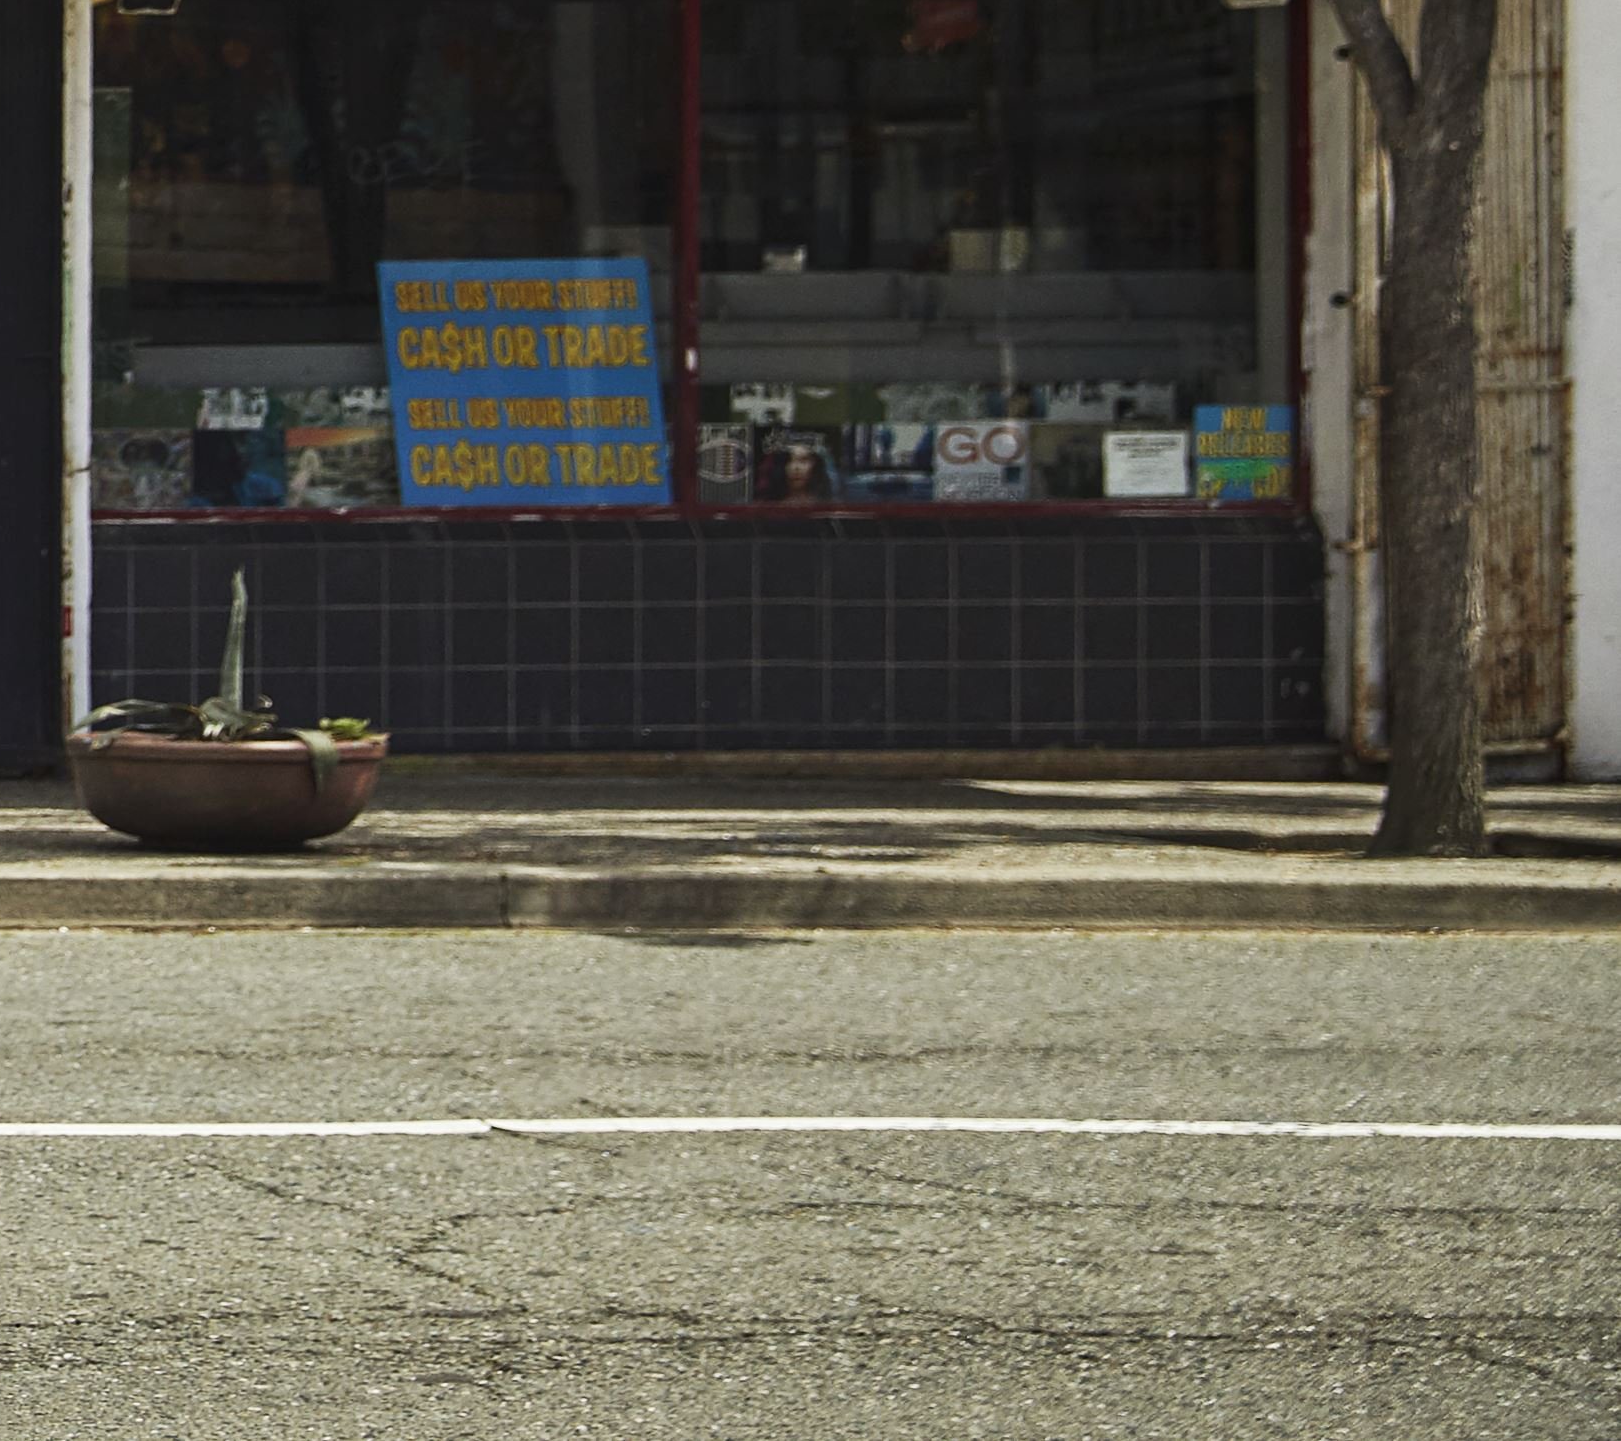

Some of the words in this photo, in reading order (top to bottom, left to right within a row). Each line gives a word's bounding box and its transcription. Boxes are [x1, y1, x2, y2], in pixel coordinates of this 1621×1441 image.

[394, 278, 450, 312] SELL
[454, 278, 487, 311] US
[490, 278, 554, 311] YOUR
[492, 324, 538, 368] OR
[542, 323, 653, 369] TRADE
[407, 397, 462, 431] SELL
[466, 397, 500, 430] US
[503, 397, 567, 429] YOUR
[504, 443, 551, 487] OR
[555, 441, 666, 487] TRADE
[937, 426, 1027, 467] GO
